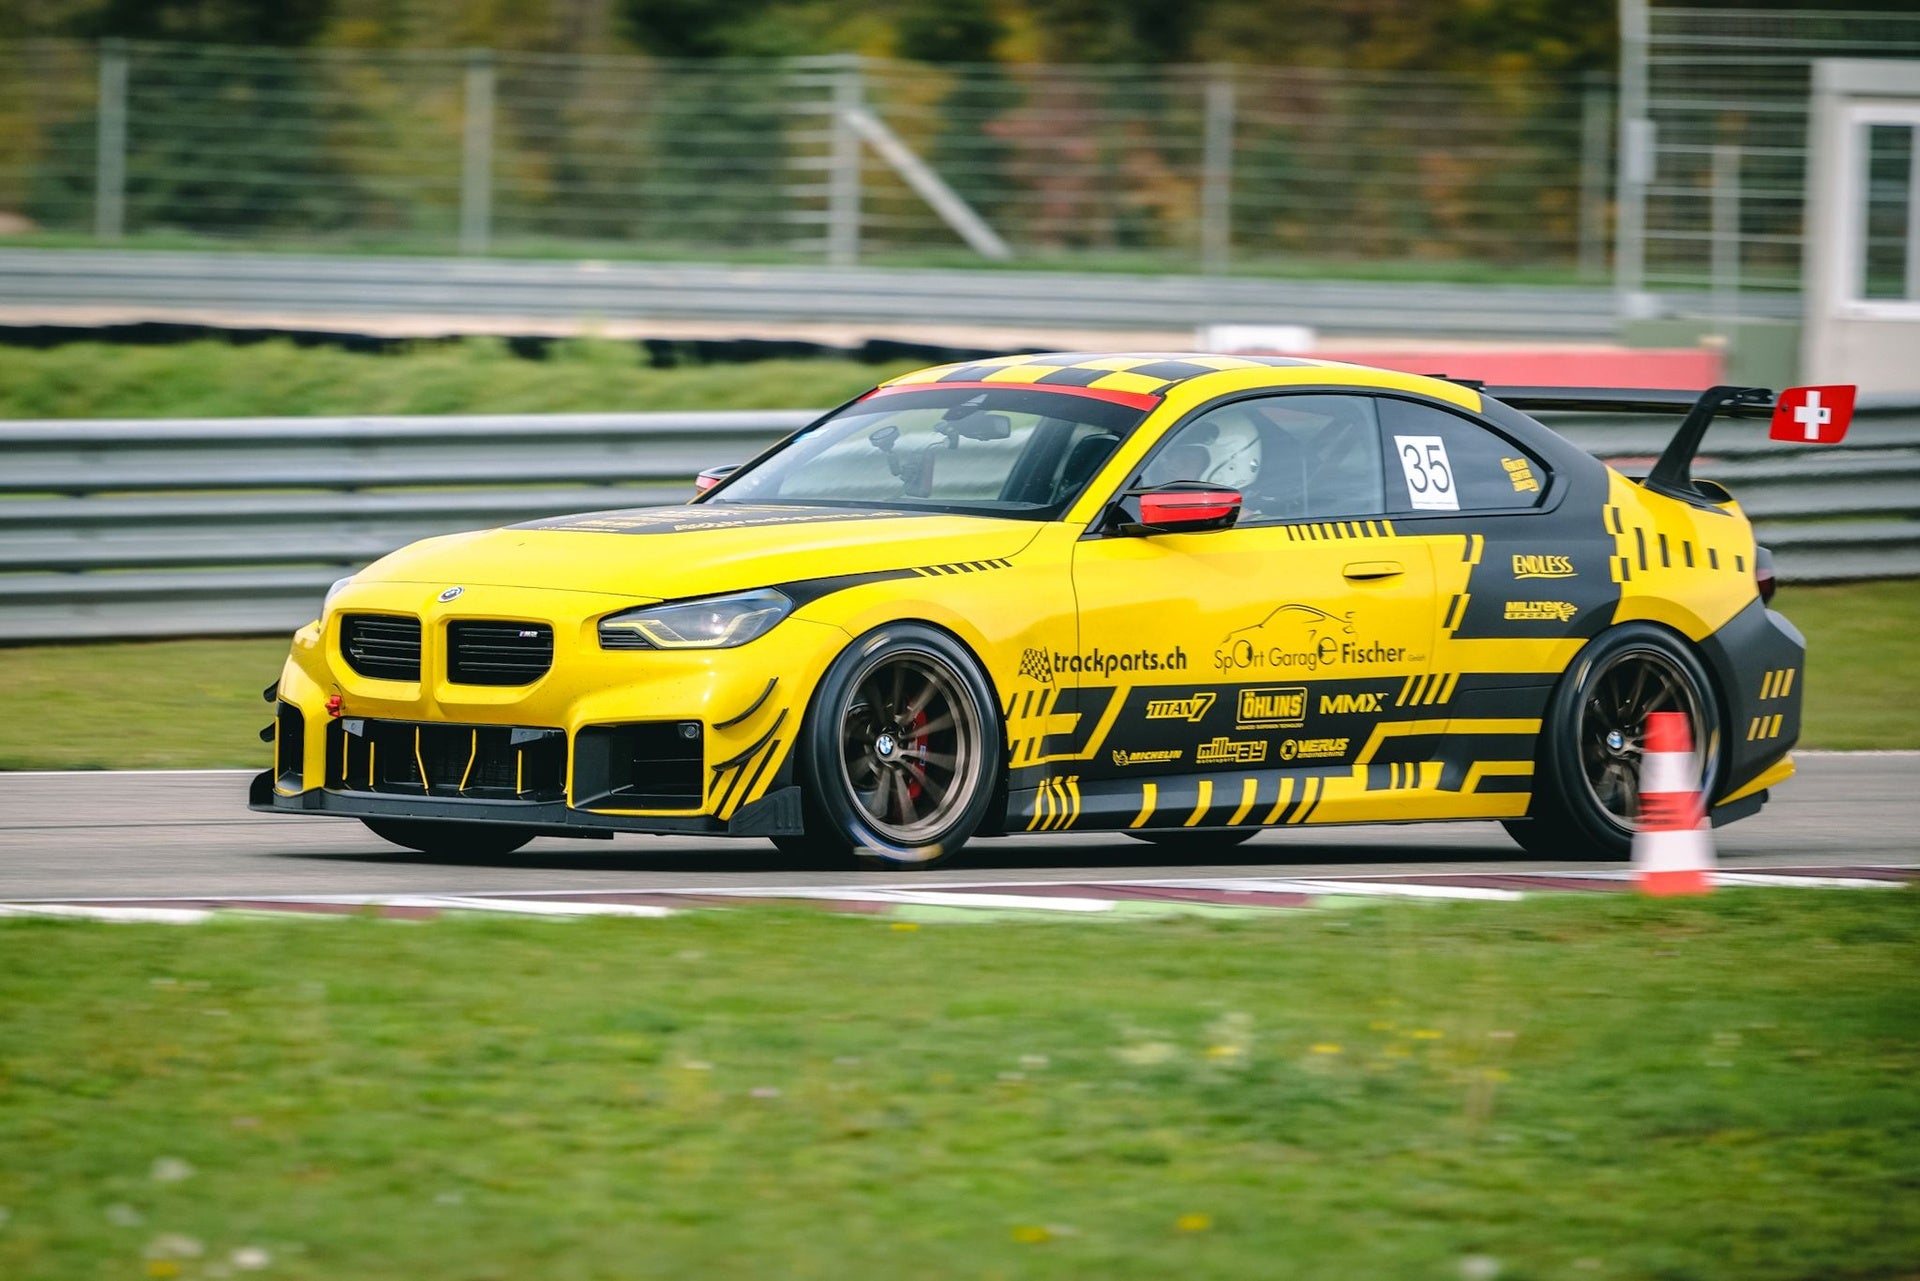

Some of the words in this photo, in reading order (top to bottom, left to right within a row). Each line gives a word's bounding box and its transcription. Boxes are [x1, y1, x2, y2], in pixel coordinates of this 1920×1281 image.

[1403, 444, 1450, 494] 35
[1512, 555, 1574, 574] ENDLESS
[1054, 645, 1187, 679] trackparts.ch
[1269, 636, 1338, 671] Garage
[1342, 640, 1406, 664] Fischer
[1242, 691, 1303, 719] ÖHLINS
[1319, 692, 1386, 715] MMX
[1129, 750, 1183, 761] MICHELIN
[1298, 738, 1350, 753] VERUS
